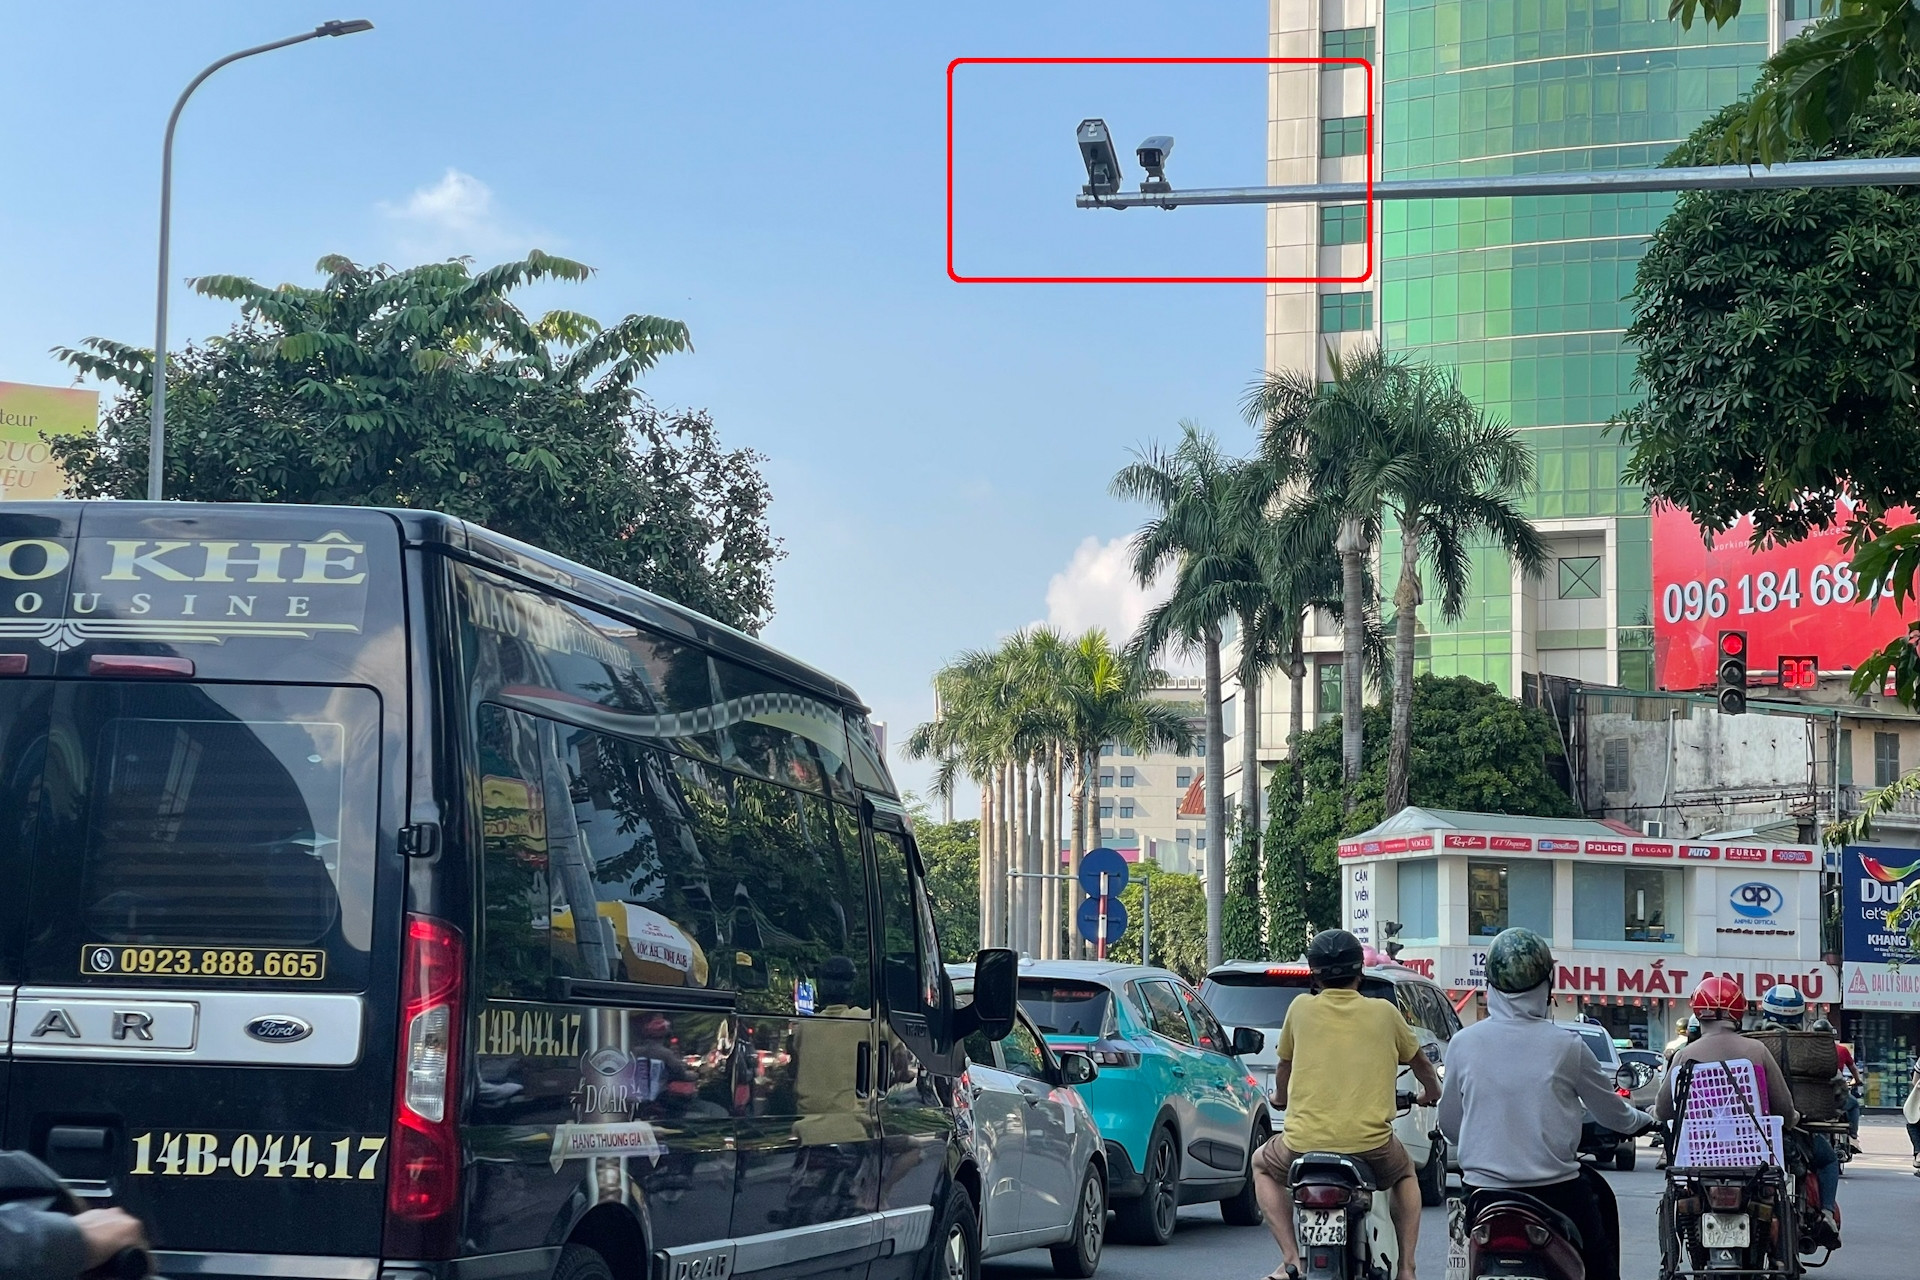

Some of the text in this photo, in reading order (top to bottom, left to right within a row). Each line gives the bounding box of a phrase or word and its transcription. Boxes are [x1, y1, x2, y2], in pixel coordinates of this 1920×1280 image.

[101, 531, 367, 584] KHÊ
[1663, 577, 1728, 624] 096
[1738, 567, 1801, 615] 184
[1782, 659, 1815, 689] 36
[1587, 844, 1624, 852] POLICE
[1730, 848, 1762, 857] FURLA
[1868, 934, 1906, 946] KHANG
[120, 948, 318, 977] 0923.888.665
[1617, 958, 1688, 994] MẮT
[1896, 975, 1913, 993] SIKA
[476, 1008, 581, 1057] 14B-044.17
[584, 1084, 628, 1114] DCAR
[628, 1131, 642, 1147] GIA
[130, 1131, 387, 1180] 14B-044.17
